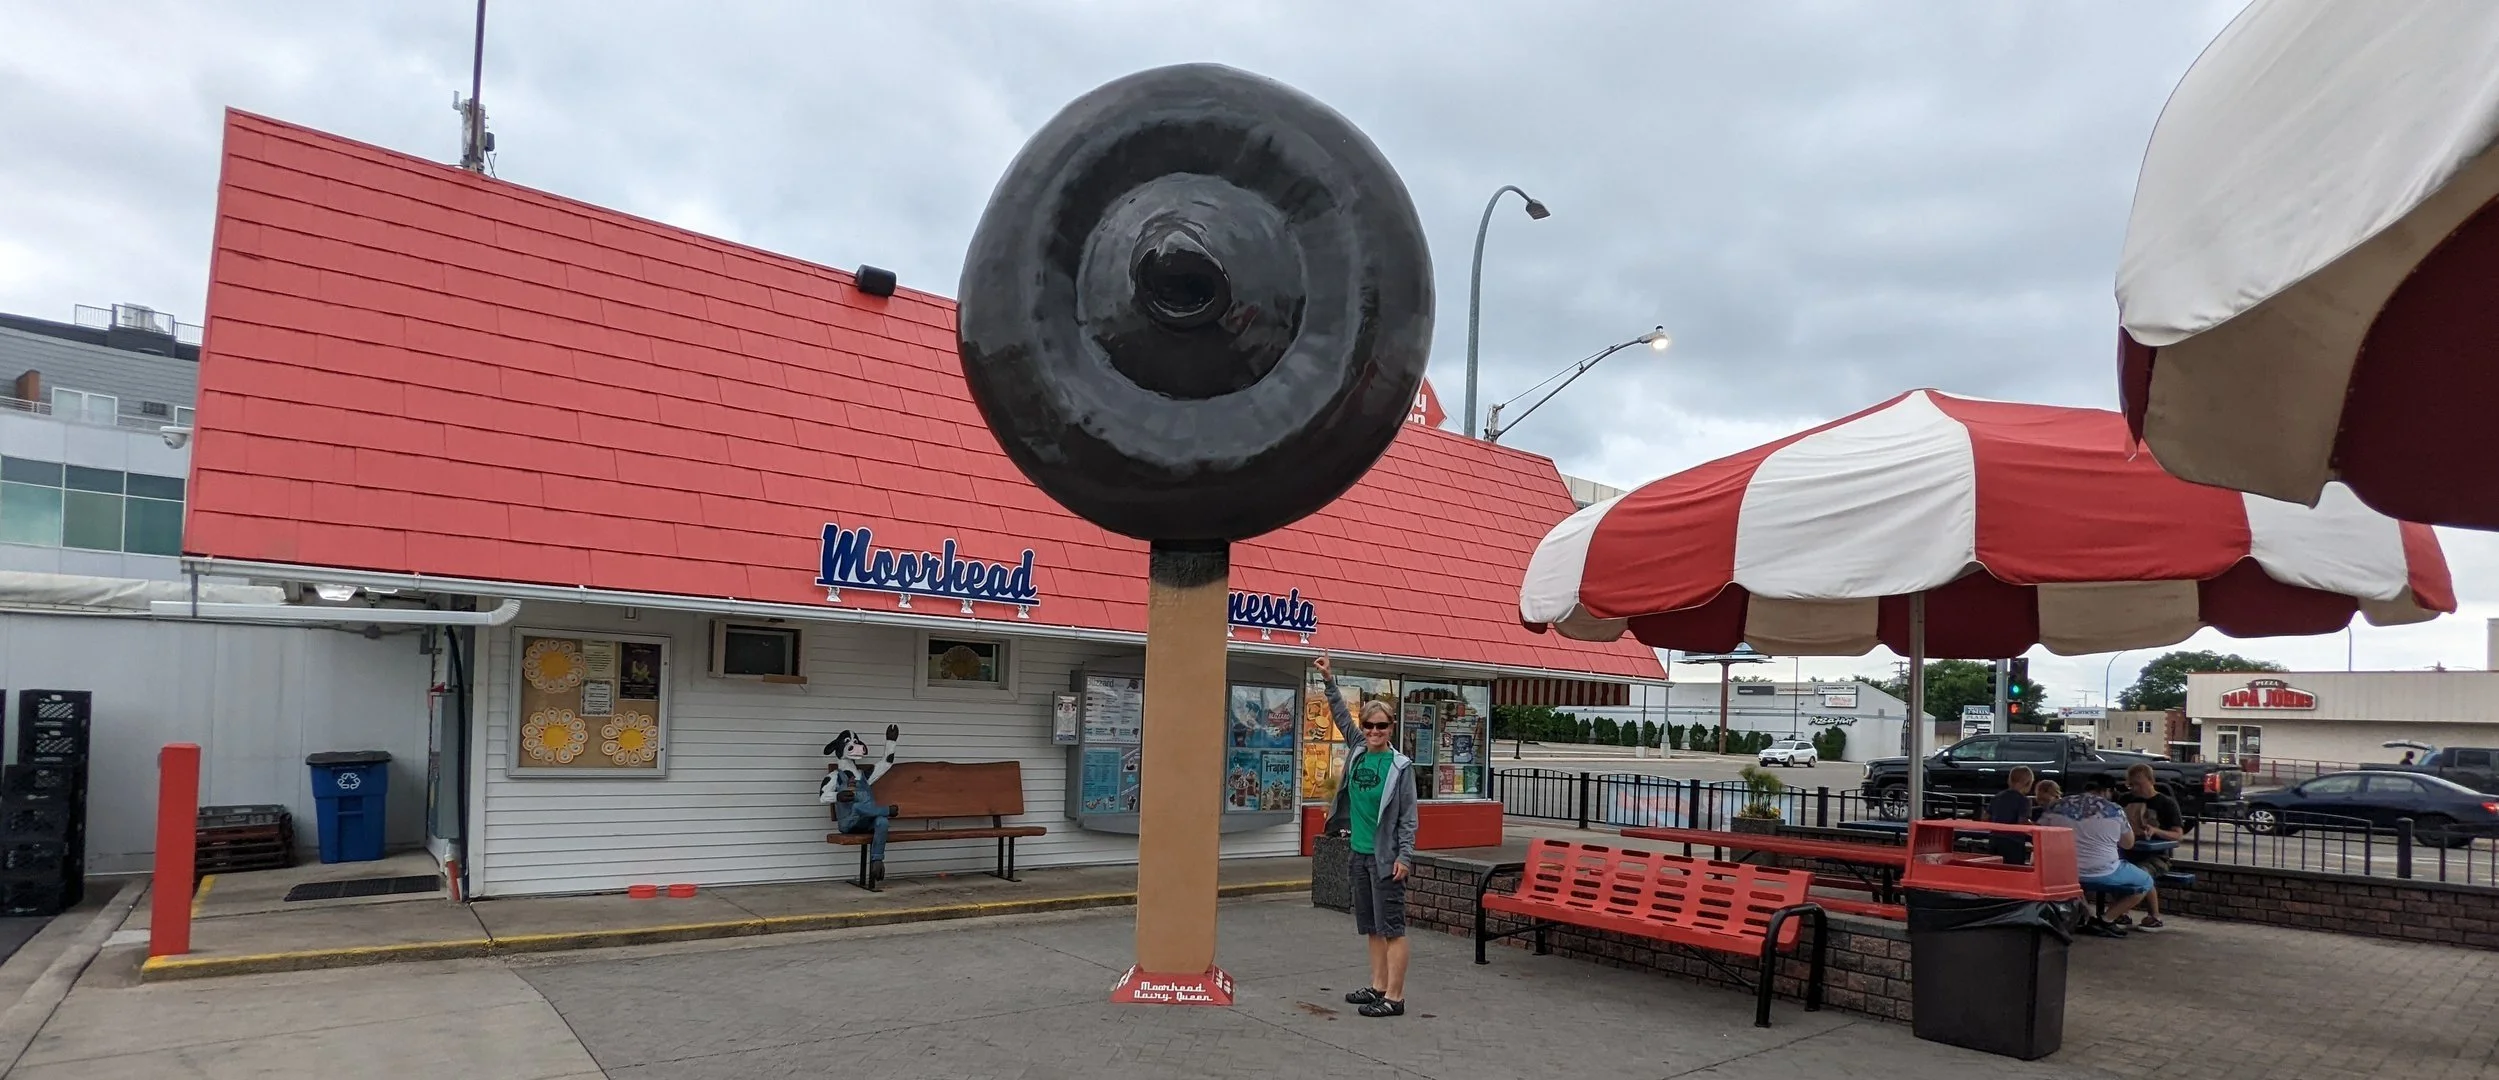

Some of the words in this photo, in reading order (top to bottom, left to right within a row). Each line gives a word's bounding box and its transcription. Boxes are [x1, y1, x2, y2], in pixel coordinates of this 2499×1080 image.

[821, 523, 1038, 600] Moorhead
[1228, 588, 1317, 629] nesota
[2222, 688, 2260, 707] PAPA
[2263, 688, 2314, 708] JOHNS
[1808, 715, 1834, 726] Pizza
[1833, 715, 1858, 727] Hut
[1140, 981, 1206, 993] Moorhead
[1134, 990, 1172, 1001] Dairy
[1176, 991, 1213, 1002] Queen
